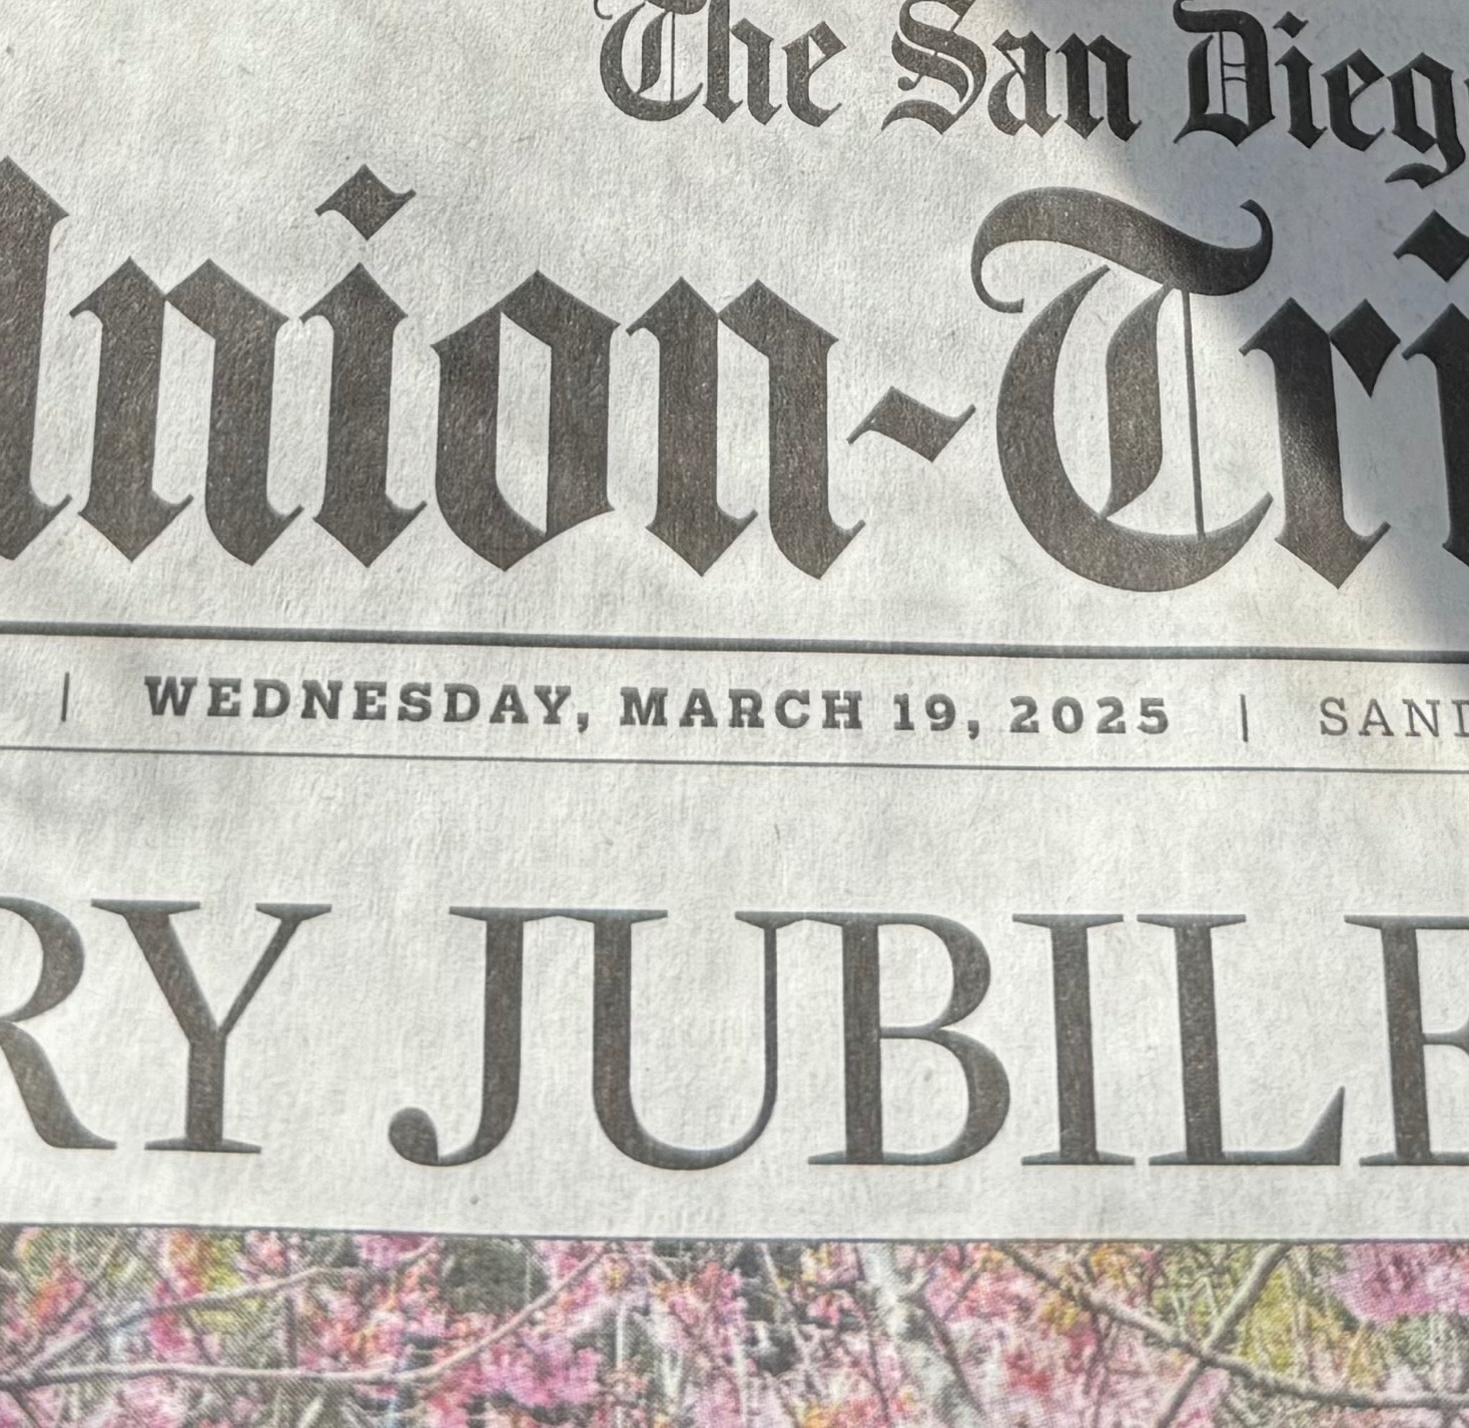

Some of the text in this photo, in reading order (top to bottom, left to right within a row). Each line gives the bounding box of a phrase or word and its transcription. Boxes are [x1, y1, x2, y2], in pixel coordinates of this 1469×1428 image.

[144, 675, 591, 734] WEDNESDAY,
[619, 685, 863, 732] MARCH
[893, 692, 982, 741] 19,
[1010, 695, 1169, 736] 2025
